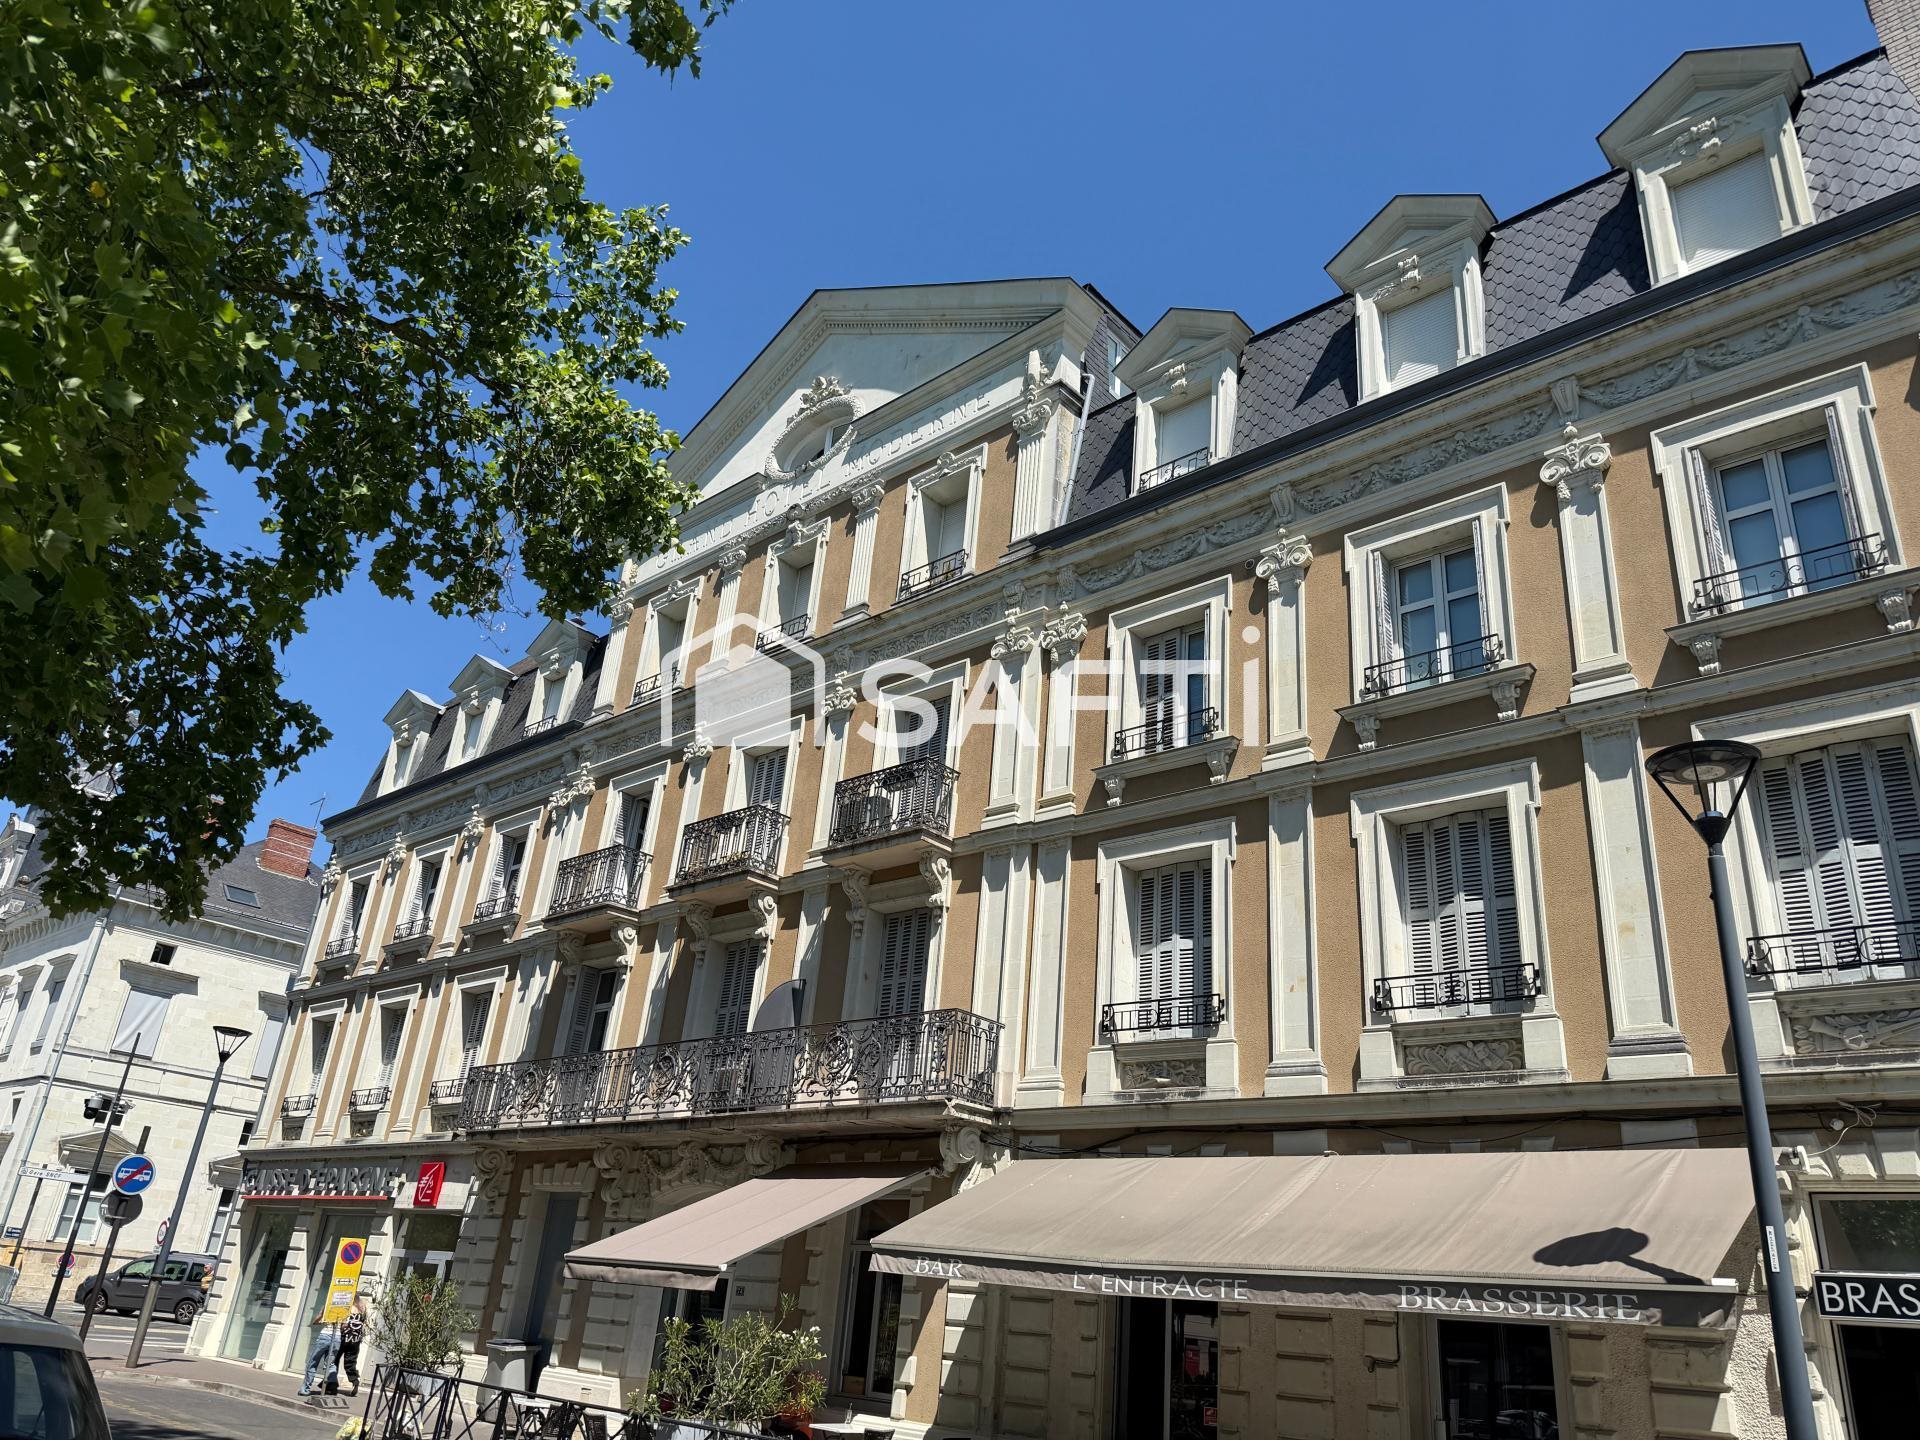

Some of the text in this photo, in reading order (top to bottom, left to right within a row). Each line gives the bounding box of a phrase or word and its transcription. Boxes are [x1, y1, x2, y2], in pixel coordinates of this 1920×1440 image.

[744, 466, 831, 527] HOTEL
[844, 381, 992, 478] MODERNE
[245, 1167, 299, 1191] CAISSE
[913, 1255, 963, 1279] BAR
[1073, 1270, 1248, 1300] L'ENTRACTE
[1820, 1281, 1920, 1317] BRAS
[1397, 1284, 1642, 1322] BRASSERIE
